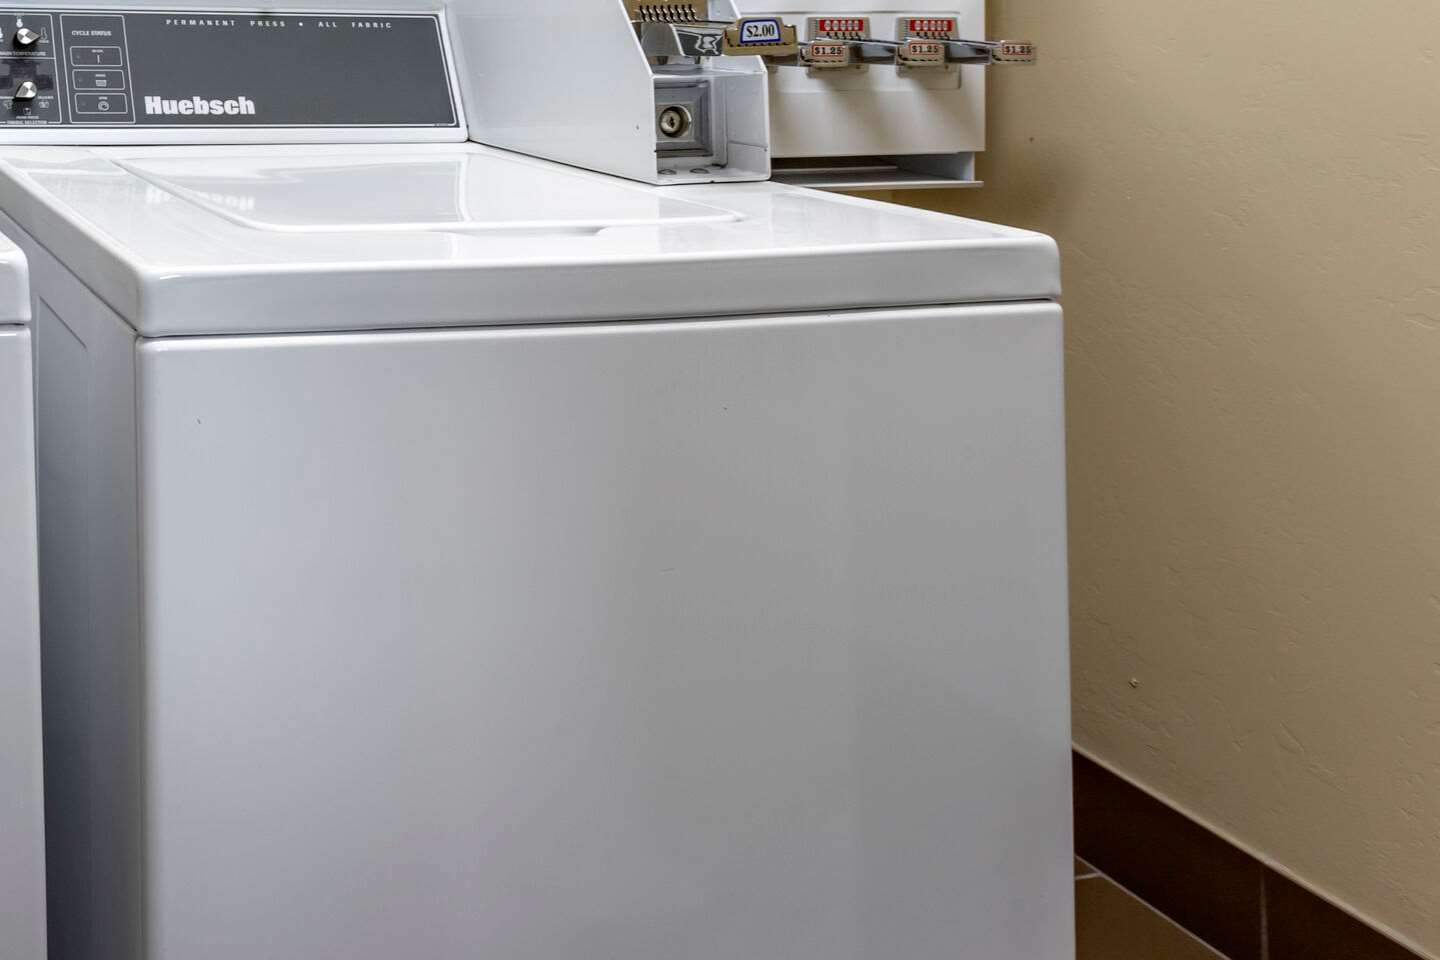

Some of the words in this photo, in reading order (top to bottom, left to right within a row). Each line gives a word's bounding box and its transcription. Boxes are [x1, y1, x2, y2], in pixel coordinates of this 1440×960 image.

[165, 19, 236, 27] PERMANENT
[351, 21, 393, 29] FABRIC
[746, 24, 775, 37] $2.00
[144, 96, 256, 115] Huebsch
